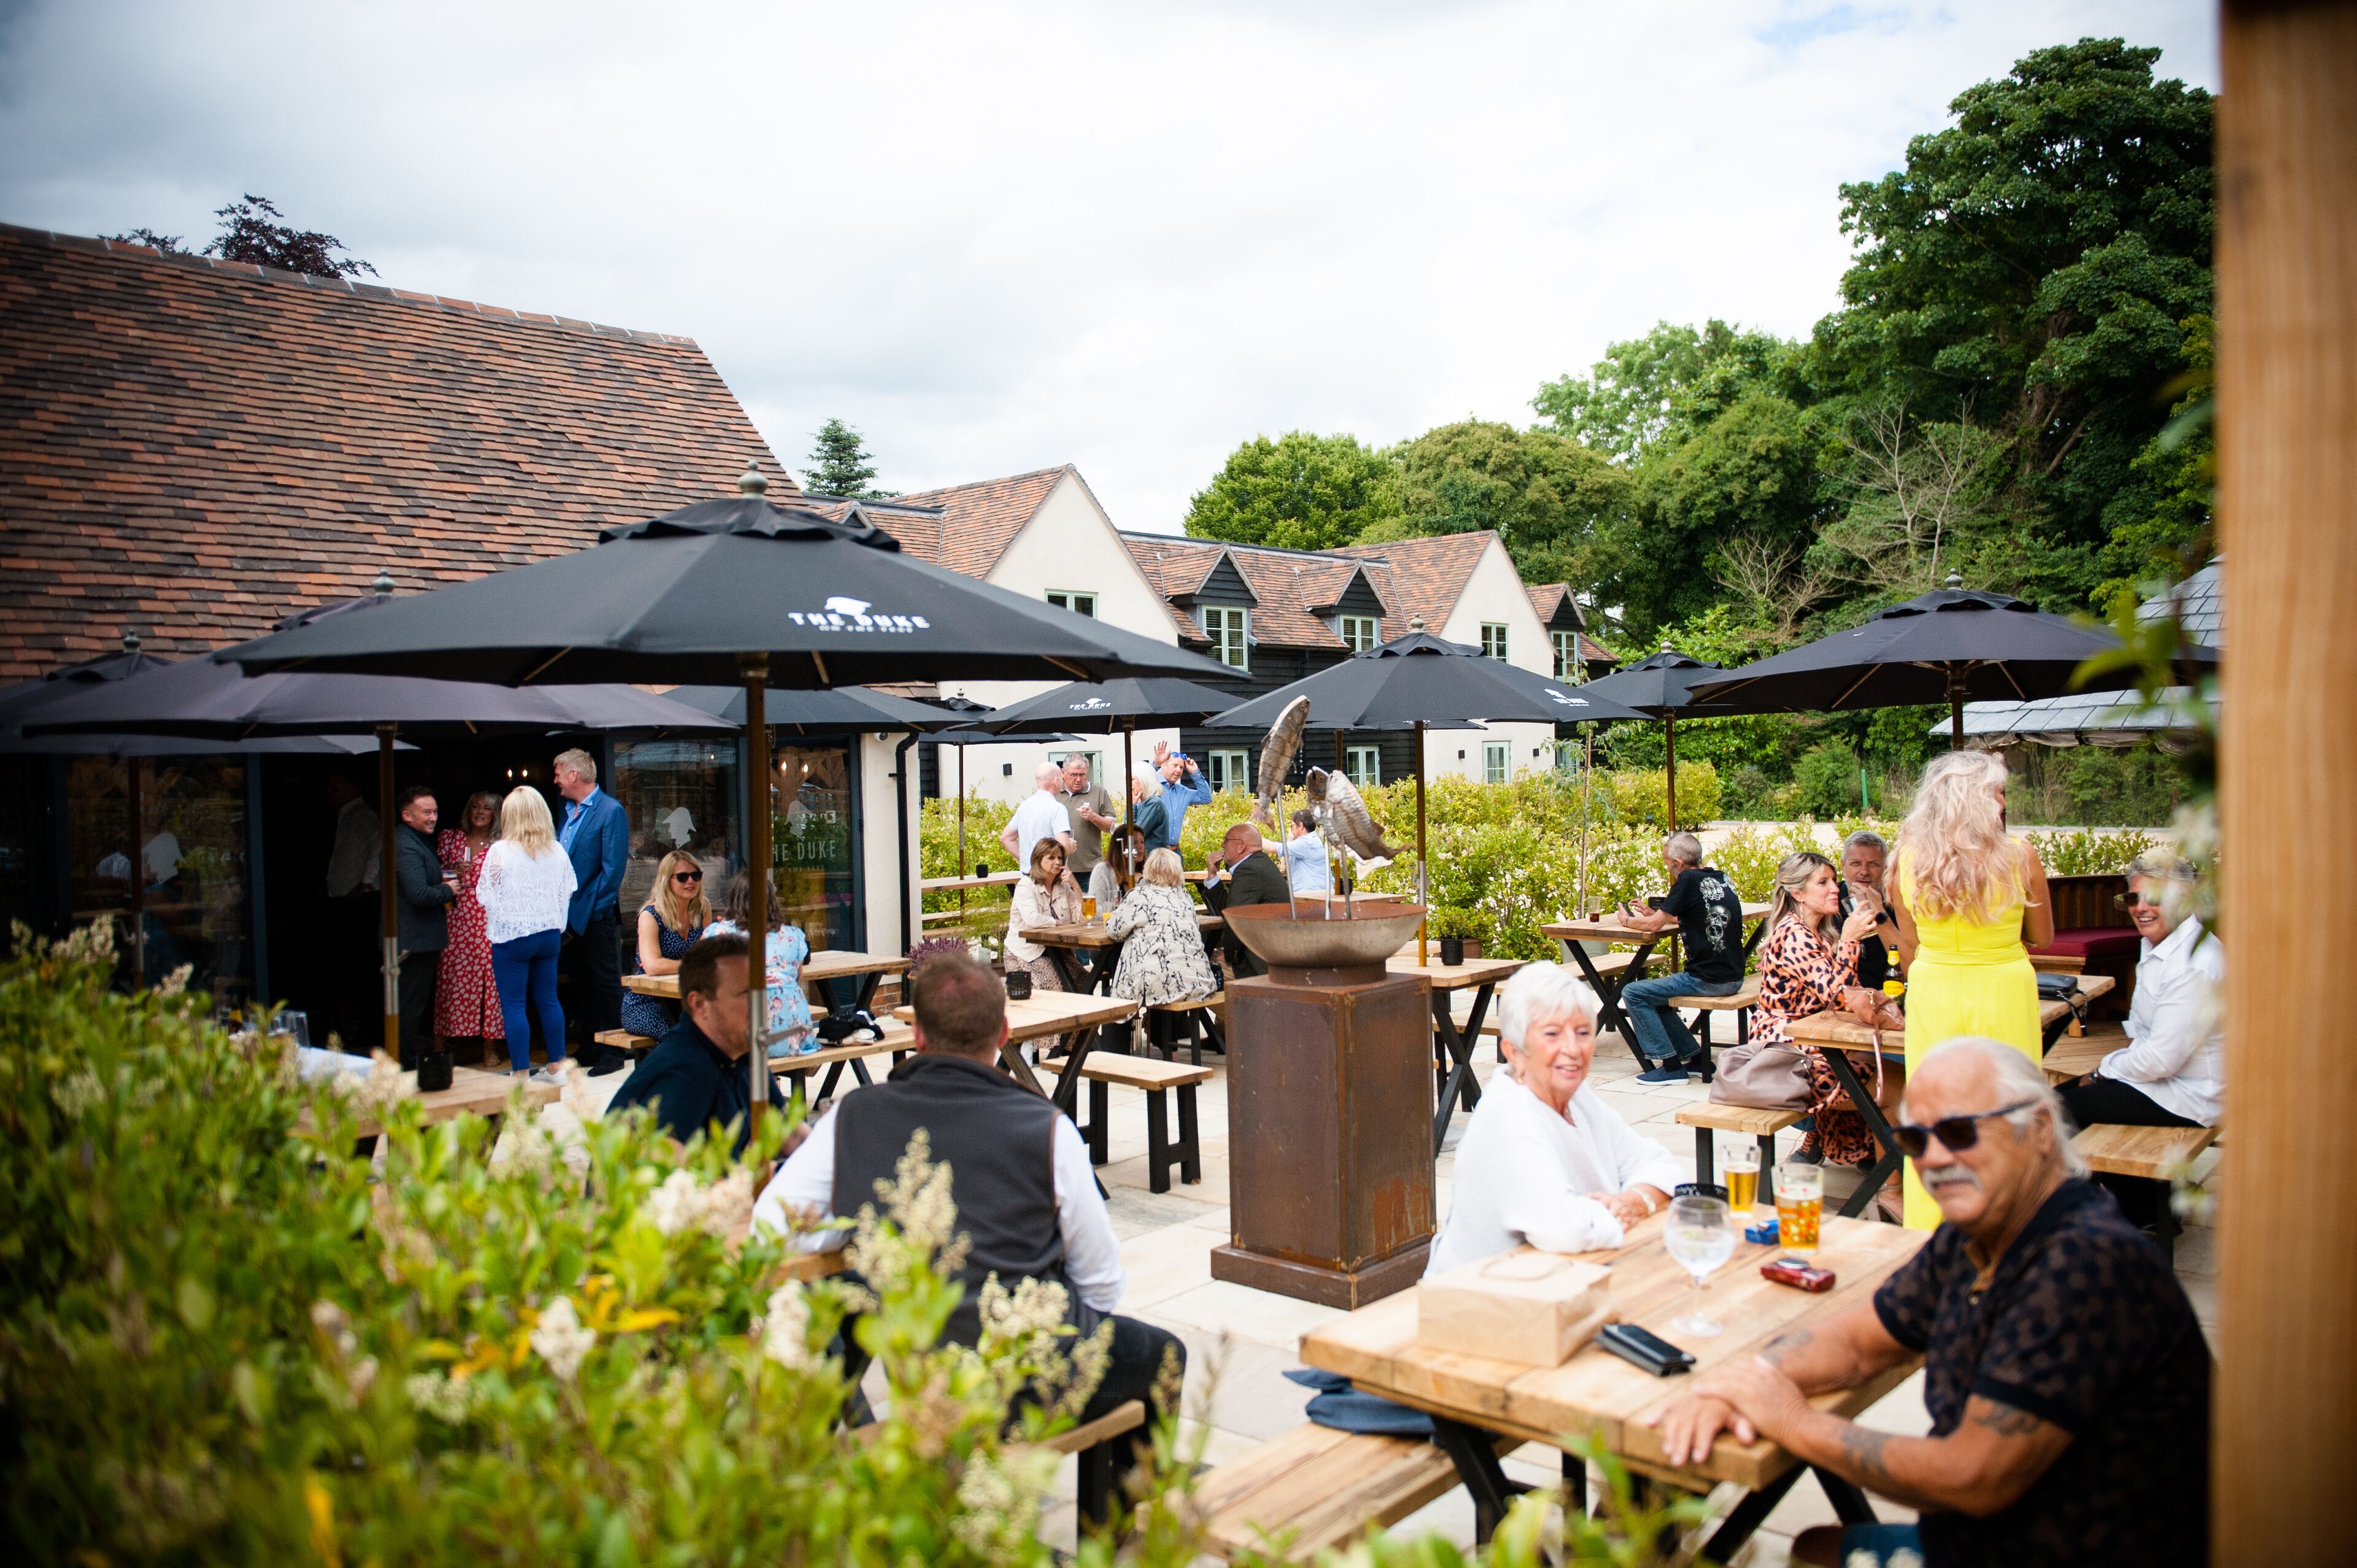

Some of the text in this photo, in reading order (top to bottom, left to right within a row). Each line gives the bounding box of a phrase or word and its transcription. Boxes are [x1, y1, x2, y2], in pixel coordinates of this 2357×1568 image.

[788, 612, 931, 628] THE DUKE
[772, 840, 836, 862] HE DUKE
